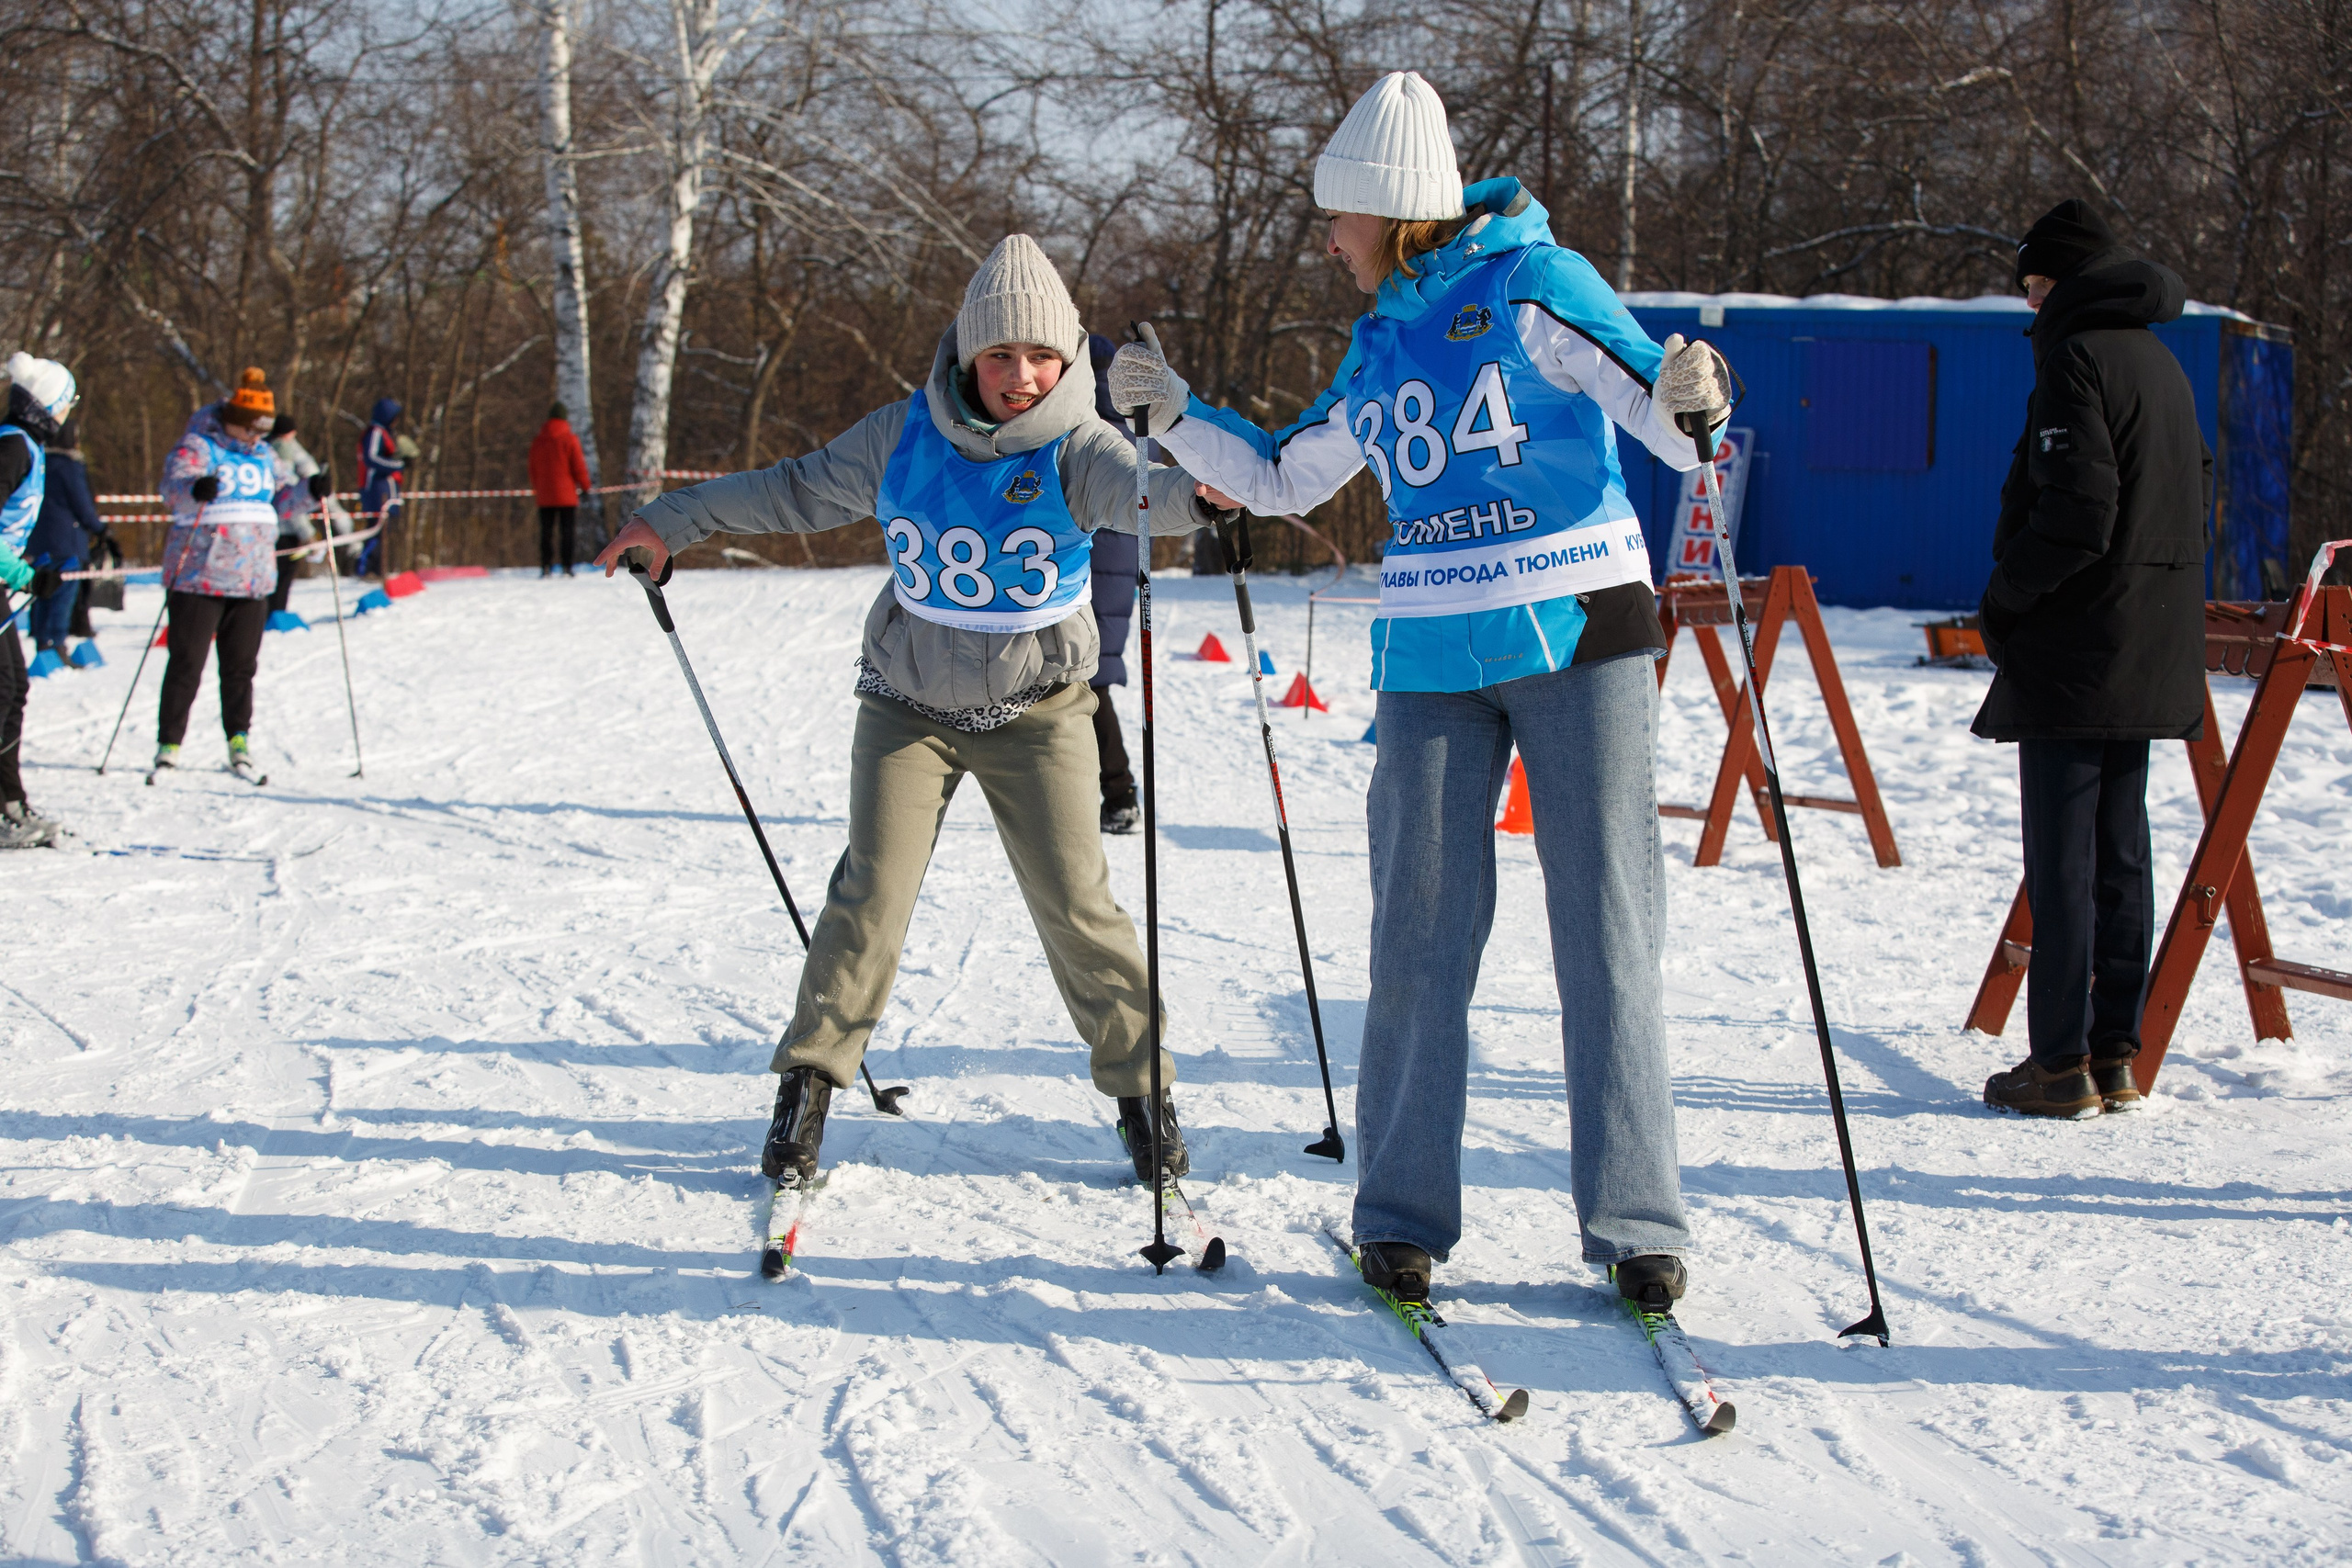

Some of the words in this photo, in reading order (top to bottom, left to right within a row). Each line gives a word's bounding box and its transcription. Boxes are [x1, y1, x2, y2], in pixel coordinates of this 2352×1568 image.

[1355, 360, 1530, 502] 384
[216, 462, 275, 497] 394
[1679, 439, 1733, 582] ИНИ
[1390, 498, 1537, 547] ЮМЕНЬ
[887, 516, 1059, 608] 383
[1424, 560, 1509, 586] ГОРОДА
[1514, 540, 1610, 574] ТЮМЕНИ
